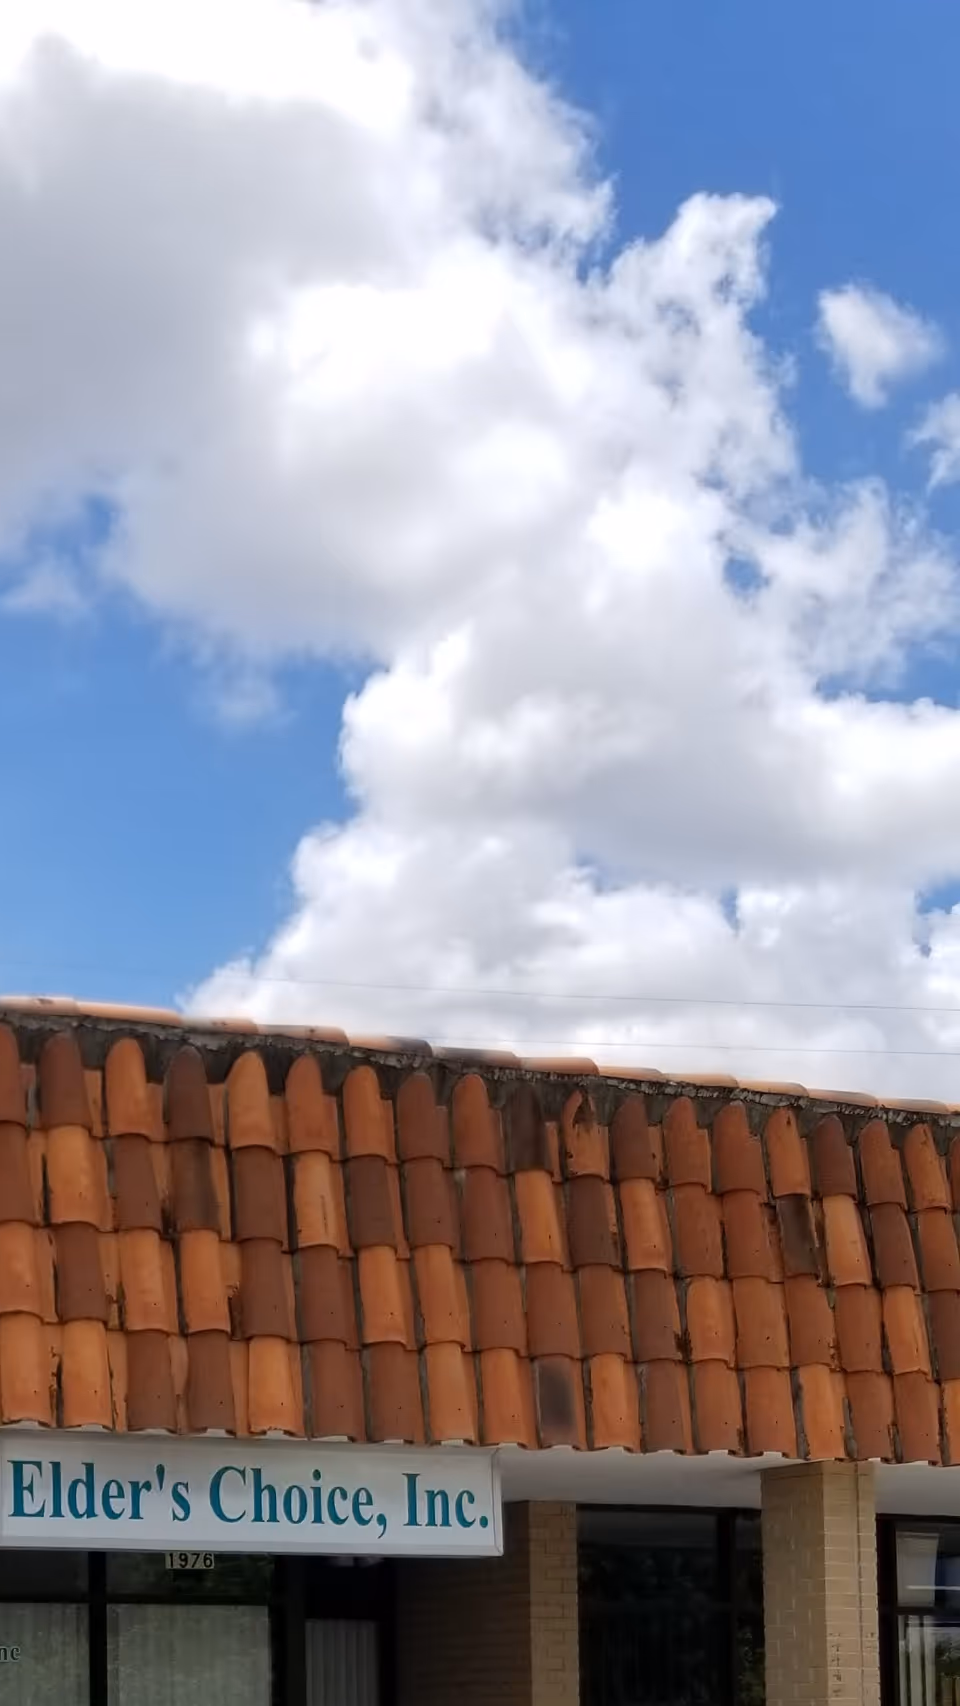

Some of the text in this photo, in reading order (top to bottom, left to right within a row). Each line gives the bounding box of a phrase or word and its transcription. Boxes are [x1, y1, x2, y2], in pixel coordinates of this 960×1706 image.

[7, 1460, 488, 1539] Elder's Choice, Inc.
[169, 1553, 213, 1568] 1976
